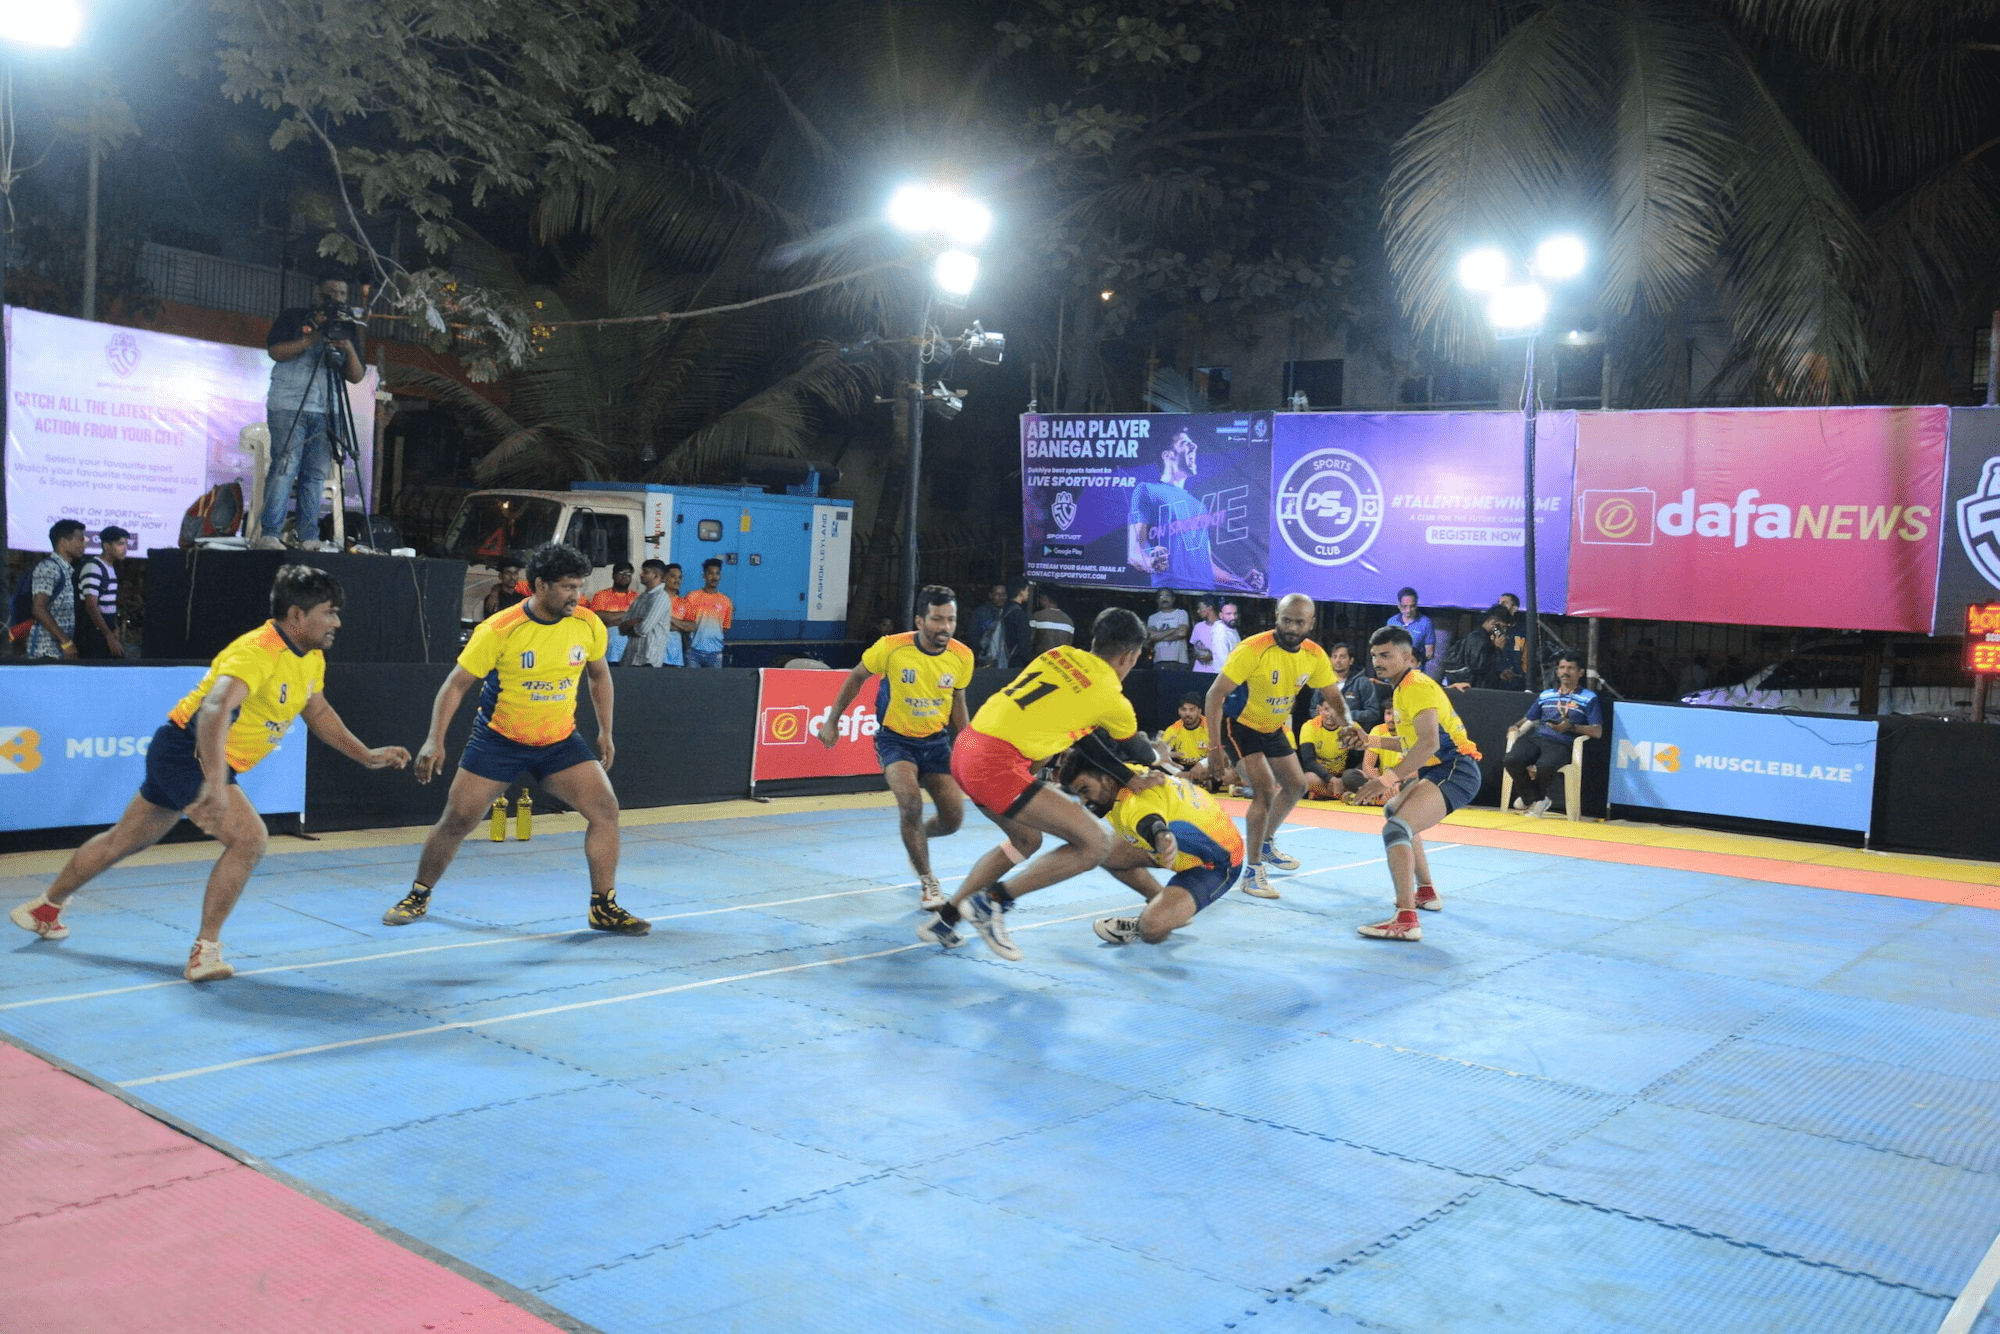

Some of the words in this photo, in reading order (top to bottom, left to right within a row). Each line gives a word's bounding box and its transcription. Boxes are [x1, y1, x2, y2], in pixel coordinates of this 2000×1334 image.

[59, 396, 81, 413] ALL
[85, 398, 108, 415] THE
[157, 407, 201, 425] SPS
[35, 417, 81, 436] ACTION
[84, 421, 118, 440] FROM
[121, 426, 153, 443] YOUR
[1027, 420, 1050, 438] AB
[1052, 420, 1086, 438] HAR
[1088, 419, 1150, 438] PLAYER
[1027, 440, 1093, 458] BANEGA
[1095, 439, 1139, 458] STAR
[45, 453, 76, 465] Select
[79, 458, 101, 468] your
[103, 459, 147, 470] favourite
[148, 464, 173, 473] sport
[1313, 458, 1352, 472] SPORTS
[14, 462, 48, 474] Watch
[51, 467, 73, 477] your
[76, 468, 120, 480] favourite
[123, 472, 179, 484] tournament
[1027, 476, 1050, 487] LIVE
[1051, 476, 1112, 487] SPORTVOT
[1112, 476, 1137, 487] PAR
[50, 477, 90, 489] Support
[92, 481, 114, 491] your
[116, 482, 140, 492] local
[61, 506, 86, 516] ONLY
[87, 507, 102, 517] ON
[1431, 529, 1487, 541] REGISTER
[1490, 530, 1522, 542] NOW
[1314, 545, 1341, 555] CLUB
[521, 650, 535, 669] 10
[902, 668, 916, 684] 30
[1272, 670, 1279, 685] 9
[279, 683, 288, 704] 8
[1695, 754, 1853, 783] MUSCLEBLAZE
